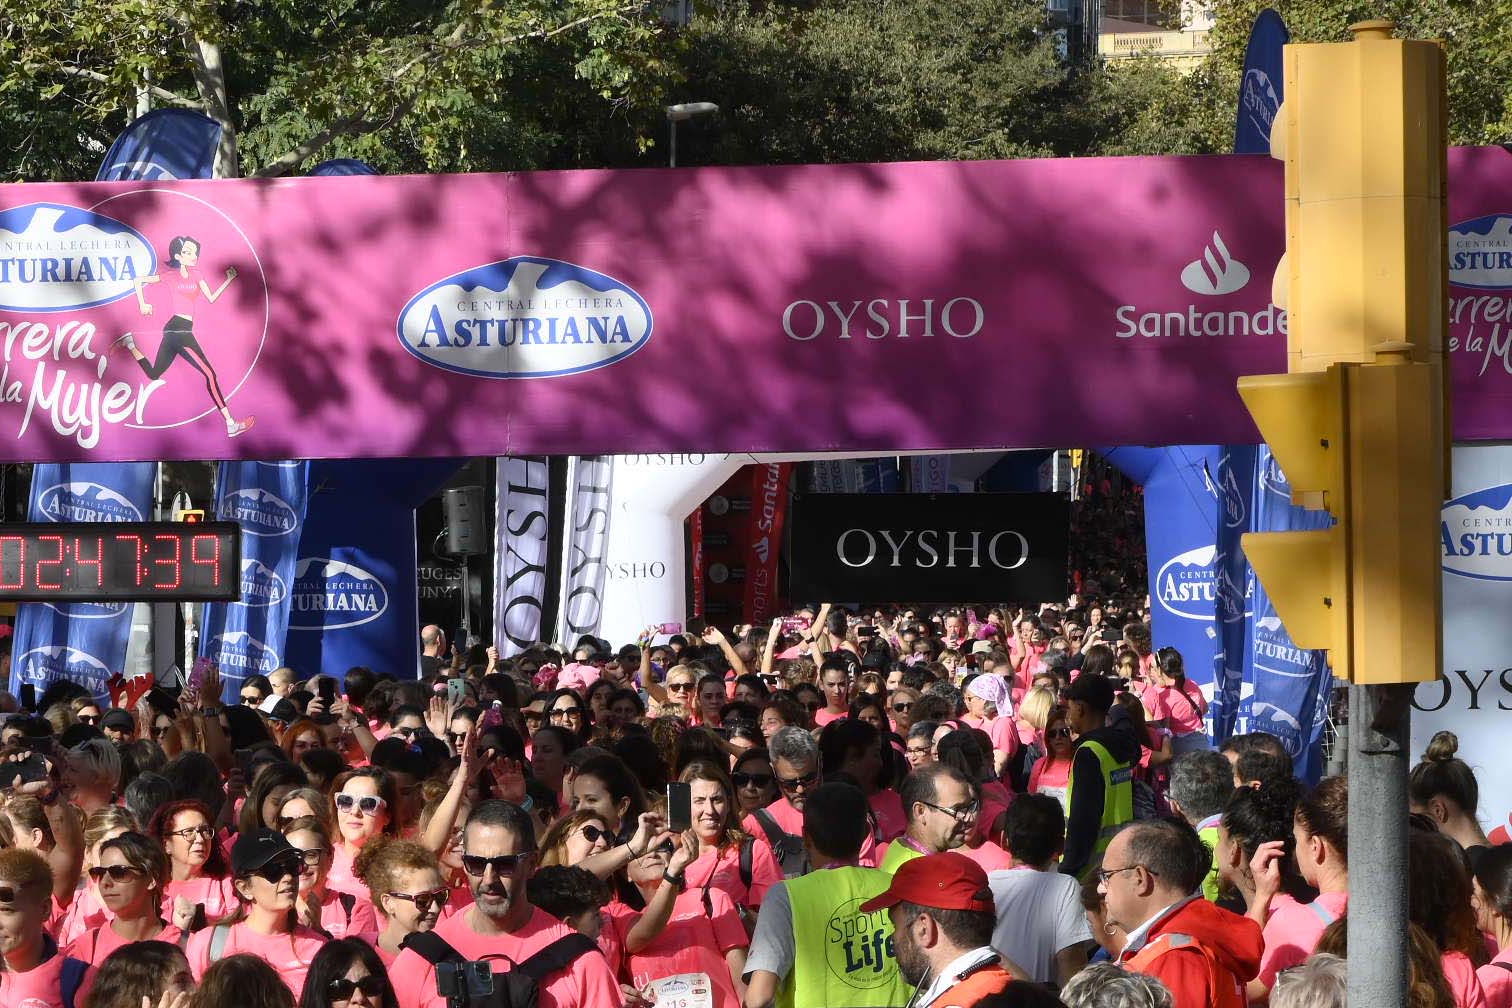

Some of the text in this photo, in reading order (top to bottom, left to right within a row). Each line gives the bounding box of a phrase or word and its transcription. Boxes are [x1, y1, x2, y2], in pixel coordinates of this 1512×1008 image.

[57, 239, 133, 251] LECHERA
[1456, 239, 1508, 248] CENTRAL
[457, 297, 625, 312] CENTRAL LECHERA
[418, 303, 633, 348] ASTURIANA
[782, 297, 985, 341] OYSHO
[1115, 303, 1289, 339] Santande
[17, 352, 167, 449] Mujer
[1462, 518, 1512, 528] CENTR
[566, 456, 610, 634] OYSH
[836, 528, 1030, 570] OYSHO
[1441, 521, 1512, 557] ASTU
[503, 456, 549, 649] OYSH
[418, 567, 463, 580] UGES
[606, 560, 666, 579] YSHO
[1180, 570, 1216, 579] CENTR
[325, 581, 375, 591] LECHERA
[1163, 575, 1217, 602] ASTU
[289, 592, 379, 613] TURIANA
